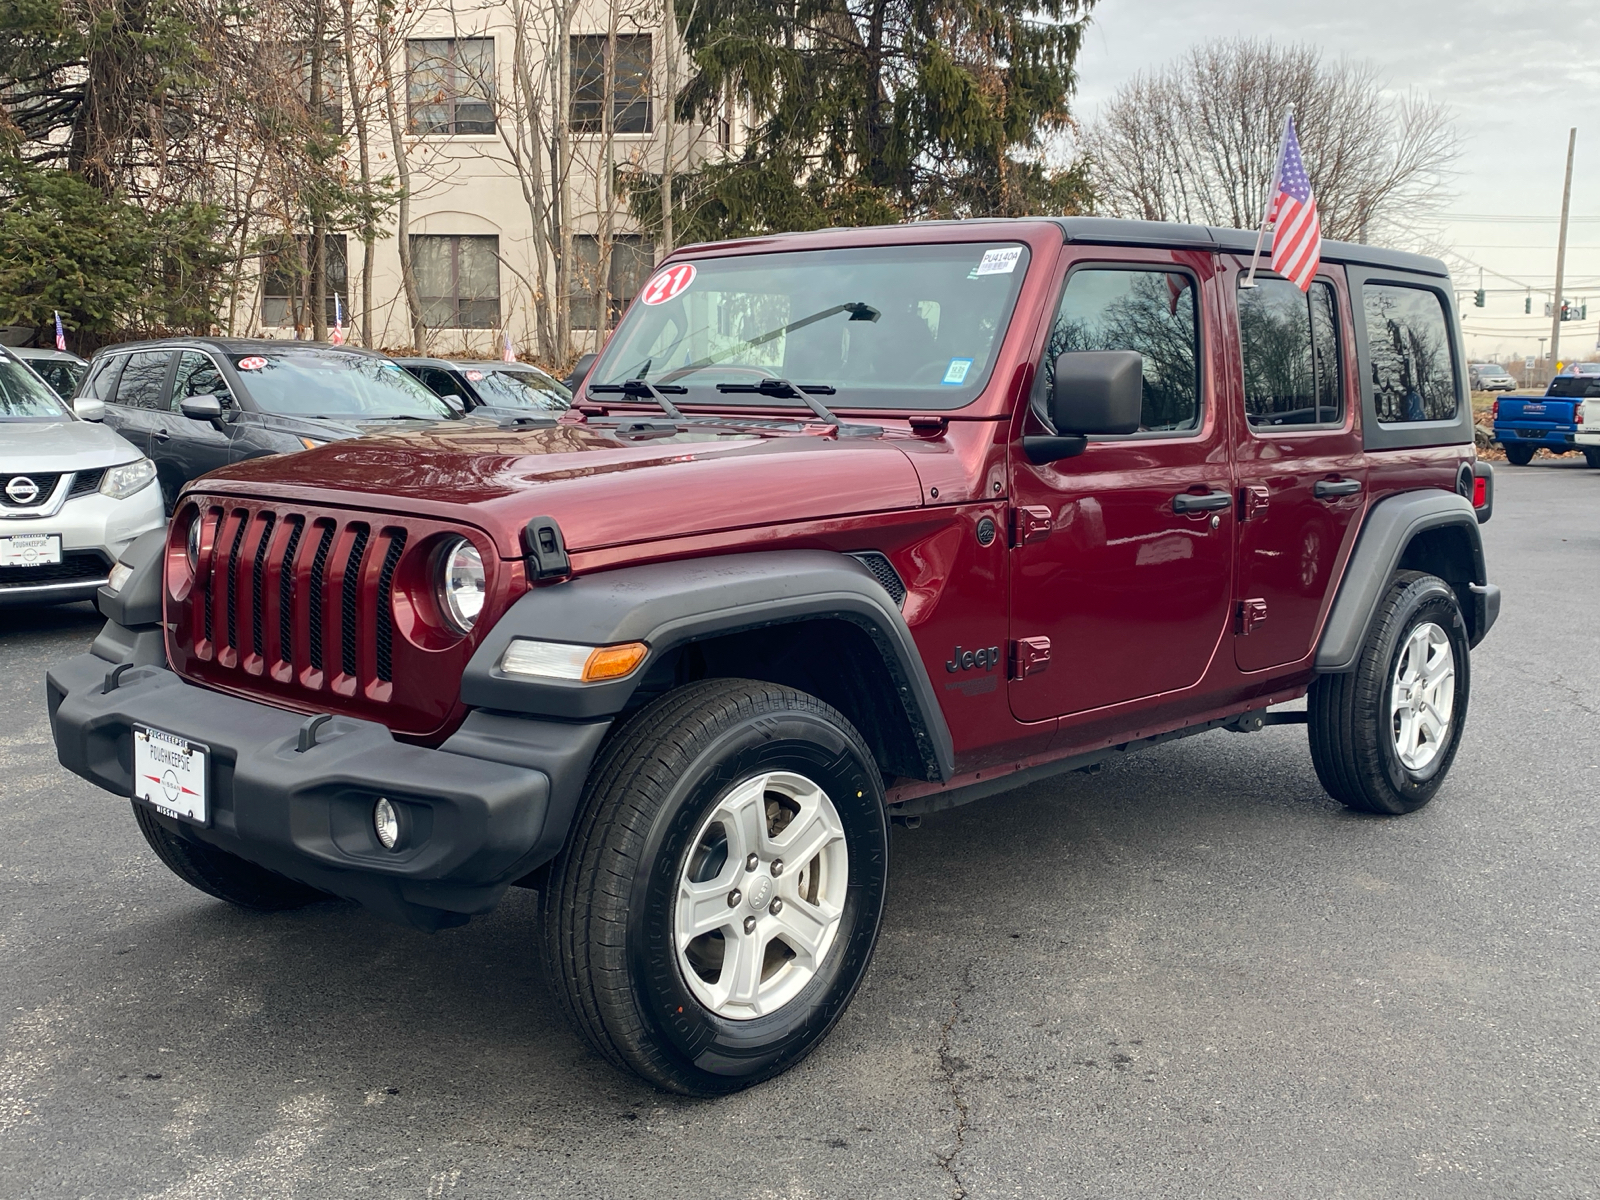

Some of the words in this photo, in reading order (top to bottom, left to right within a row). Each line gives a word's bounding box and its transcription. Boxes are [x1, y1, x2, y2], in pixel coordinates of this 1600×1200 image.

[983, 252, 1018, 262] PU4140A
[647, 266, 688, 303] 21
[945, 645, 999, 673] Jeep
[150, 744, 191, 772] POUGHKEEPSIE
[157, 805, 178, 819] NISSAN
